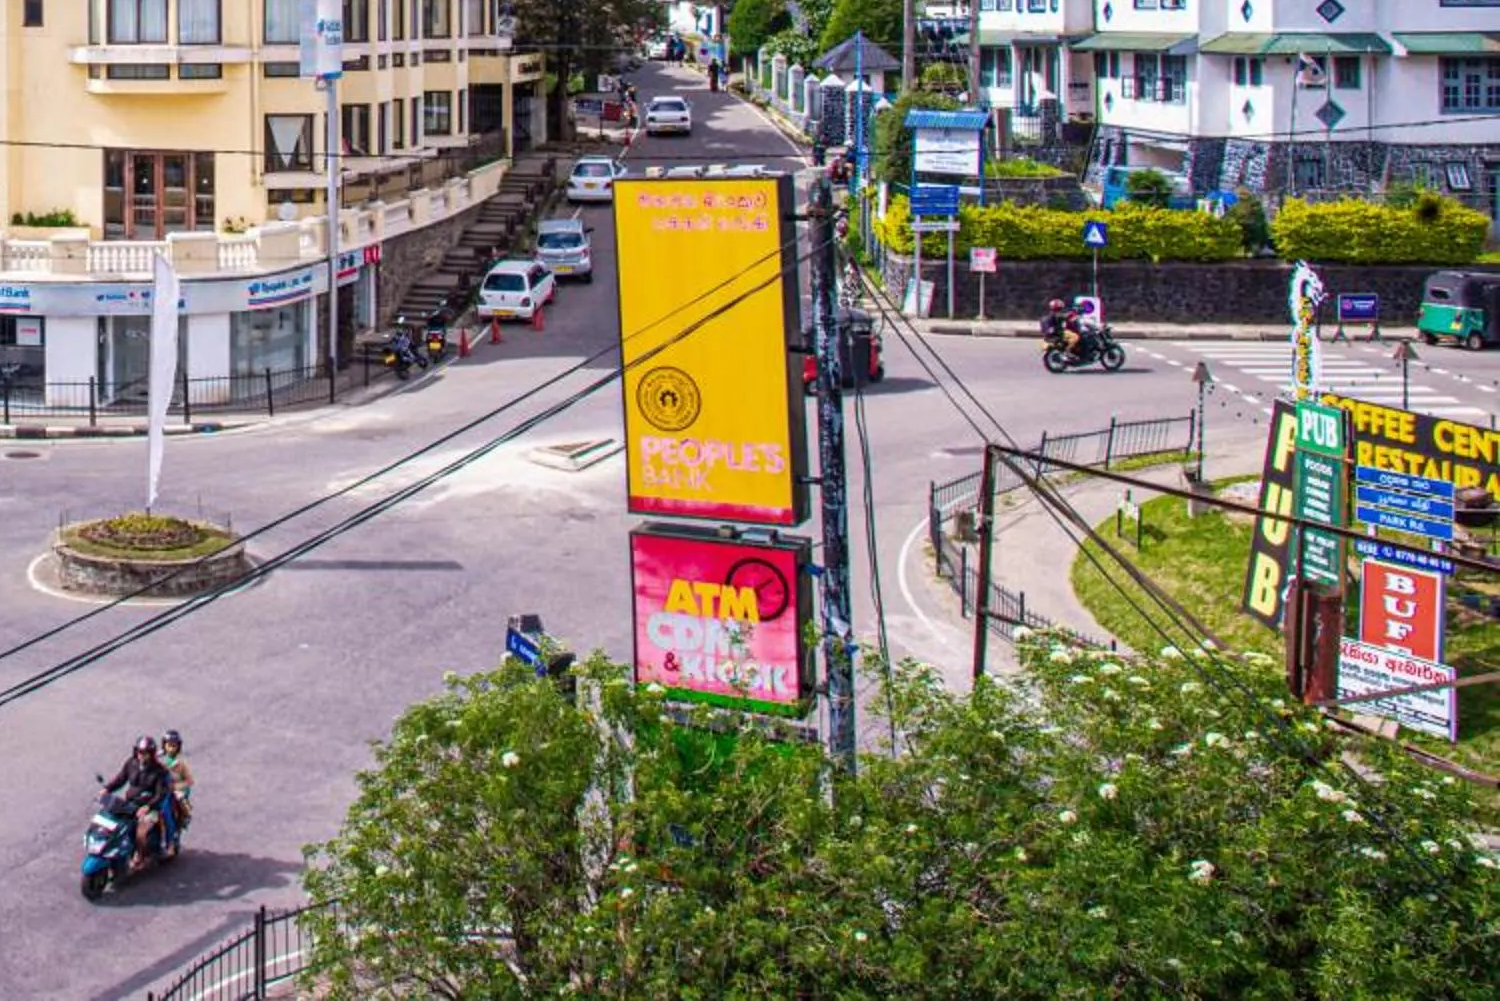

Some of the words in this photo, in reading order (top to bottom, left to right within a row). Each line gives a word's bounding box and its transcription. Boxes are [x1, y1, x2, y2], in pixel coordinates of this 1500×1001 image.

[1301, 407, 1339, 449] PUB
[1322, 395, 1417, 445] OFFEE
[642, 465, 715, 492] BANK
[663, 577, 760, 624] ATM
[1382, 572, 1418, 654] BUF
[663, 651, 681, 672] &
